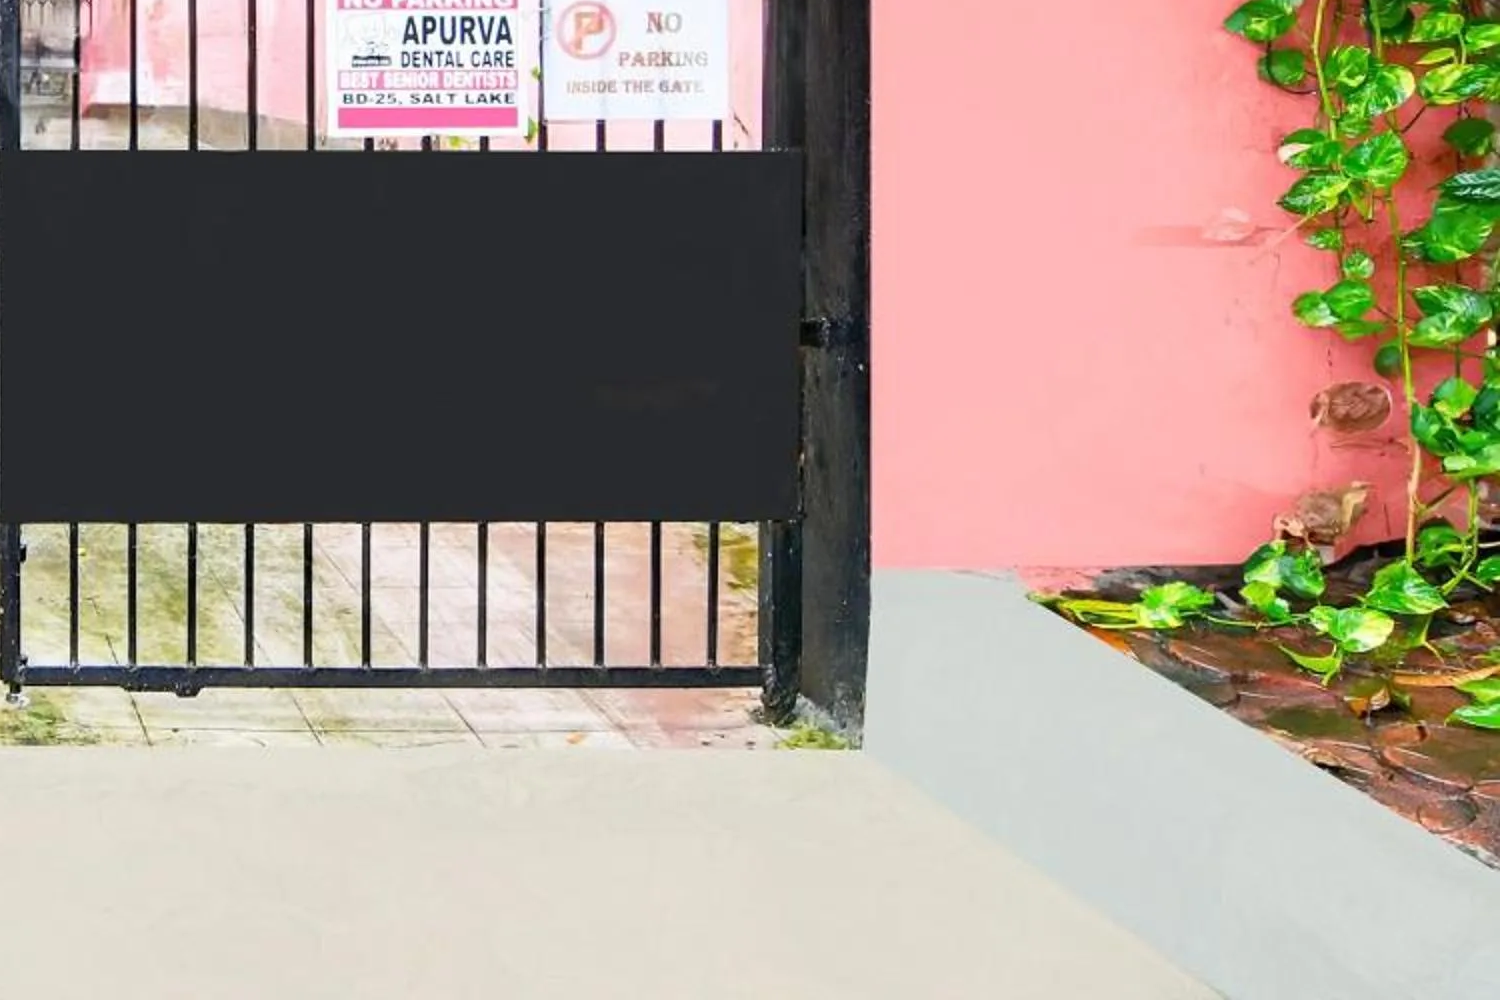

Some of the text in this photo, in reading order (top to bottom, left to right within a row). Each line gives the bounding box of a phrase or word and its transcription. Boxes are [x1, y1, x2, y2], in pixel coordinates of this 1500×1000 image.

[402, 15, 513, 45] APURVA
[646, 12, 683, 34] NO
[401, 51, 515, 68] DENTAL CARE
[618, 50, 709, 67] PARKING
[340, 71, 378, 89] BEST
[443, 71, 517, 89] DENTISTS
[566, 79, 706, 94] INSIDE THE GATE
[409, 93, 457, 105] SALT
[465, 93, 516, 105] LAKE
